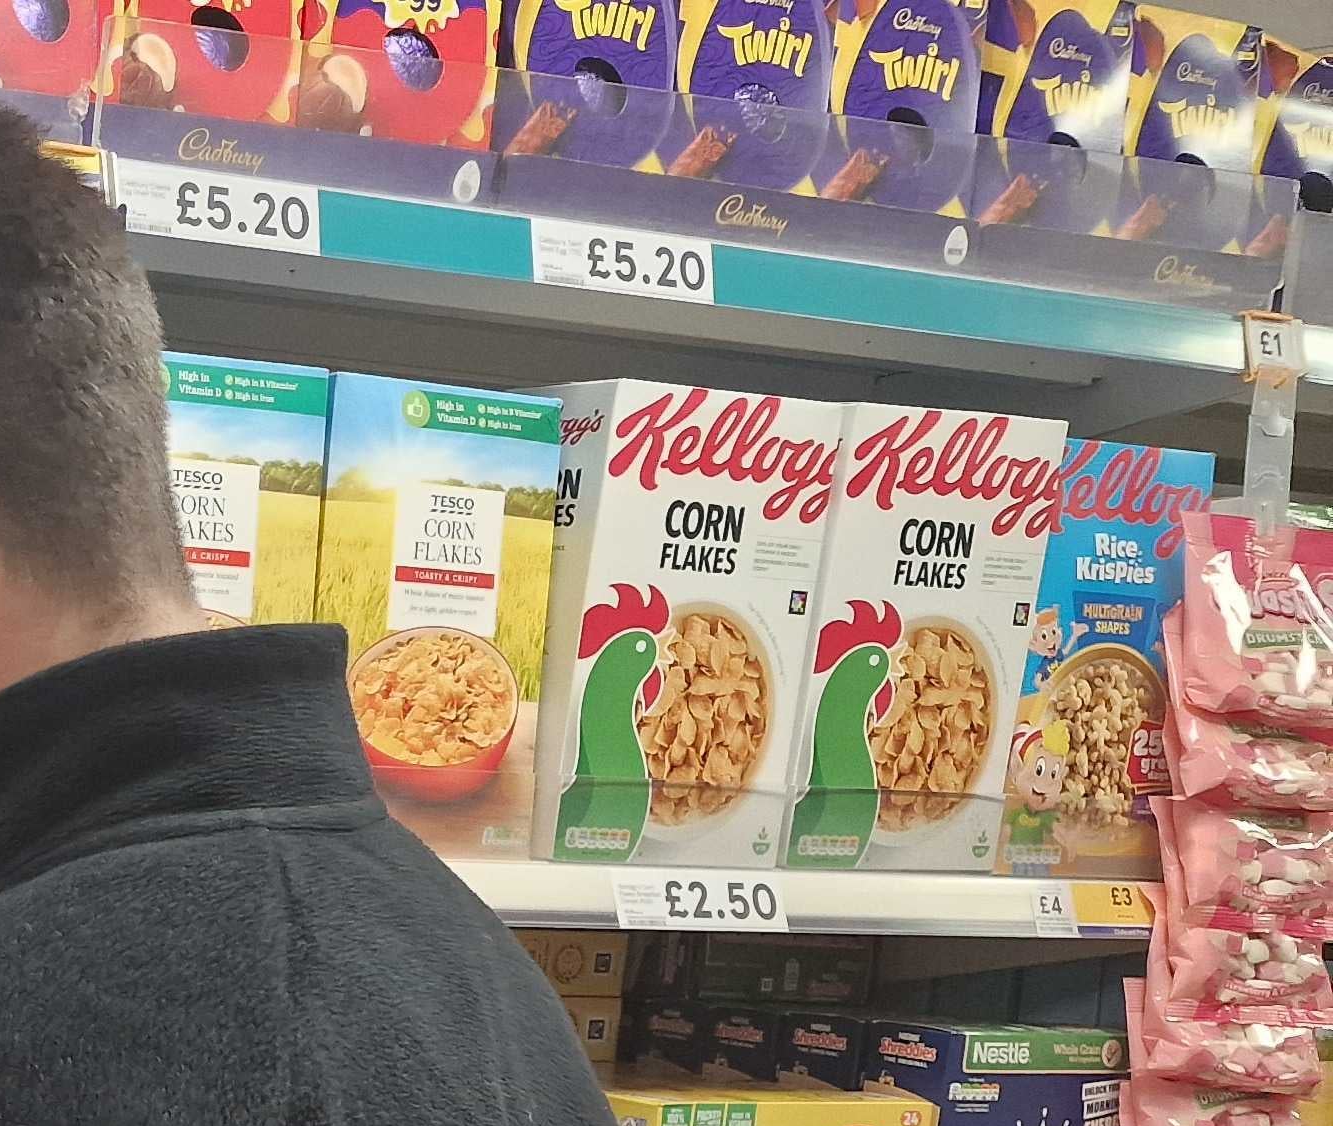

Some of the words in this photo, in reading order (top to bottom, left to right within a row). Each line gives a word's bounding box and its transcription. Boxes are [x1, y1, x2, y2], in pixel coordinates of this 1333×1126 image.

[869, 44, 960, 102] Twirl
[177, 181, 309, 240] £5.20
[716, 195, 789, 236] Cadbury
[1259, 328, 1284, 357] £1
[431, 495, 474, 511] TESCO
[424, 519, 476, 541] CORN
[665, 501, 744, 542] CORN
[413, 542, 482, 565] FLAKES
[659, 543, 736, 573] FLAKES
[666, 882, 776, 920] £2.50
[1111, 887, 1132, 905] £3
